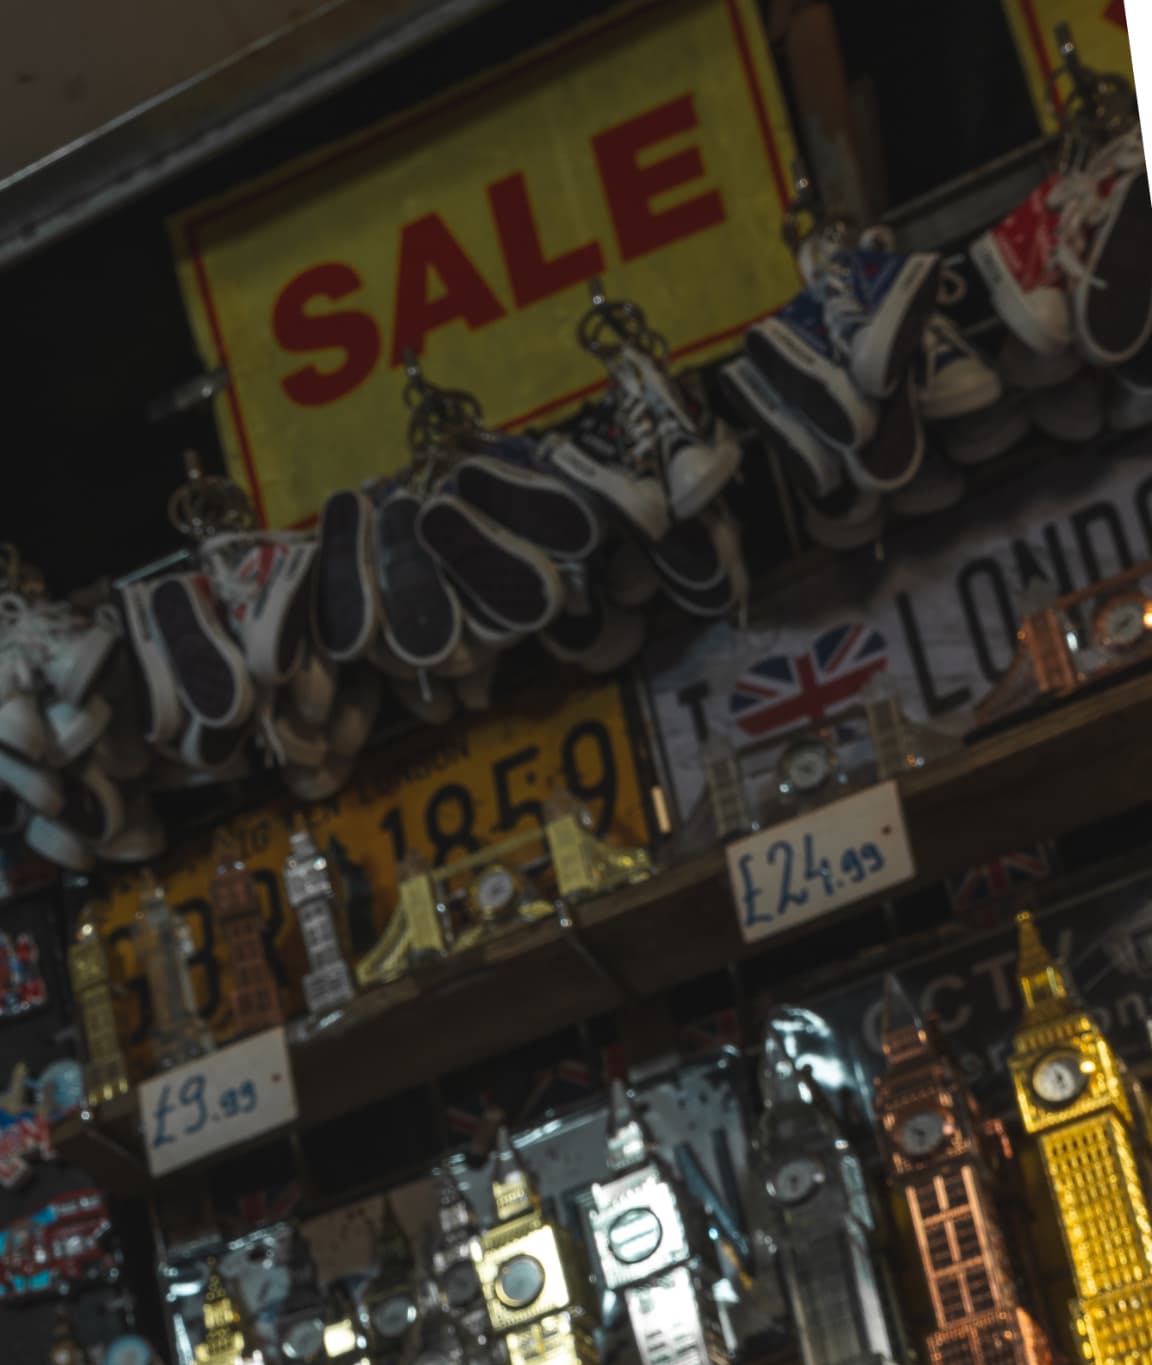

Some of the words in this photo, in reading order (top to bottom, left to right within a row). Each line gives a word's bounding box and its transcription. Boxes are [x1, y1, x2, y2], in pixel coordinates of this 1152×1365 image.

[271, 95, 726, 407] SALE
[737, 832, 888, 930] £24.99
[150, 1073, 258, 1150] £9.99
